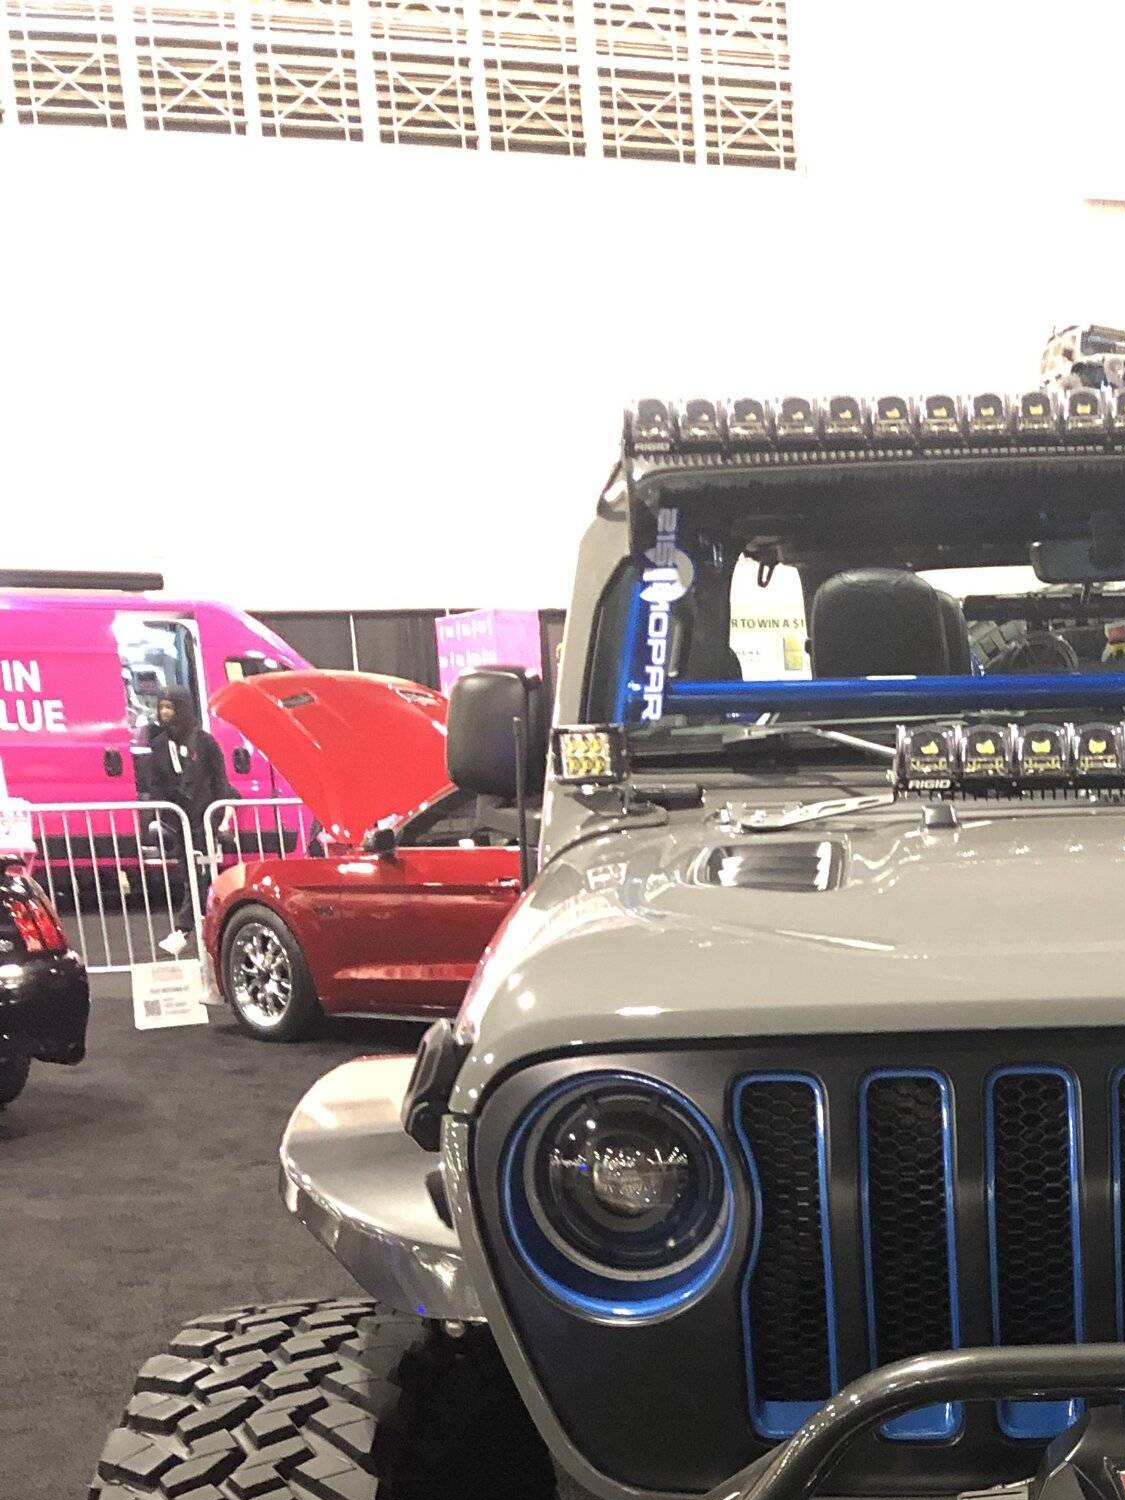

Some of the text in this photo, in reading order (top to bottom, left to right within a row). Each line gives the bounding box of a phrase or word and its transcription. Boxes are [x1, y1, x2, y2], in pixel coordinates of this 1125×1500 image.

[740, 618, 755, 629] TO
[757, 618, 780, 629] WIN
[783, 618, 790, 628] A
[0, 659, 42, 693] IN
[908, 779, 951, 790] RIGID
